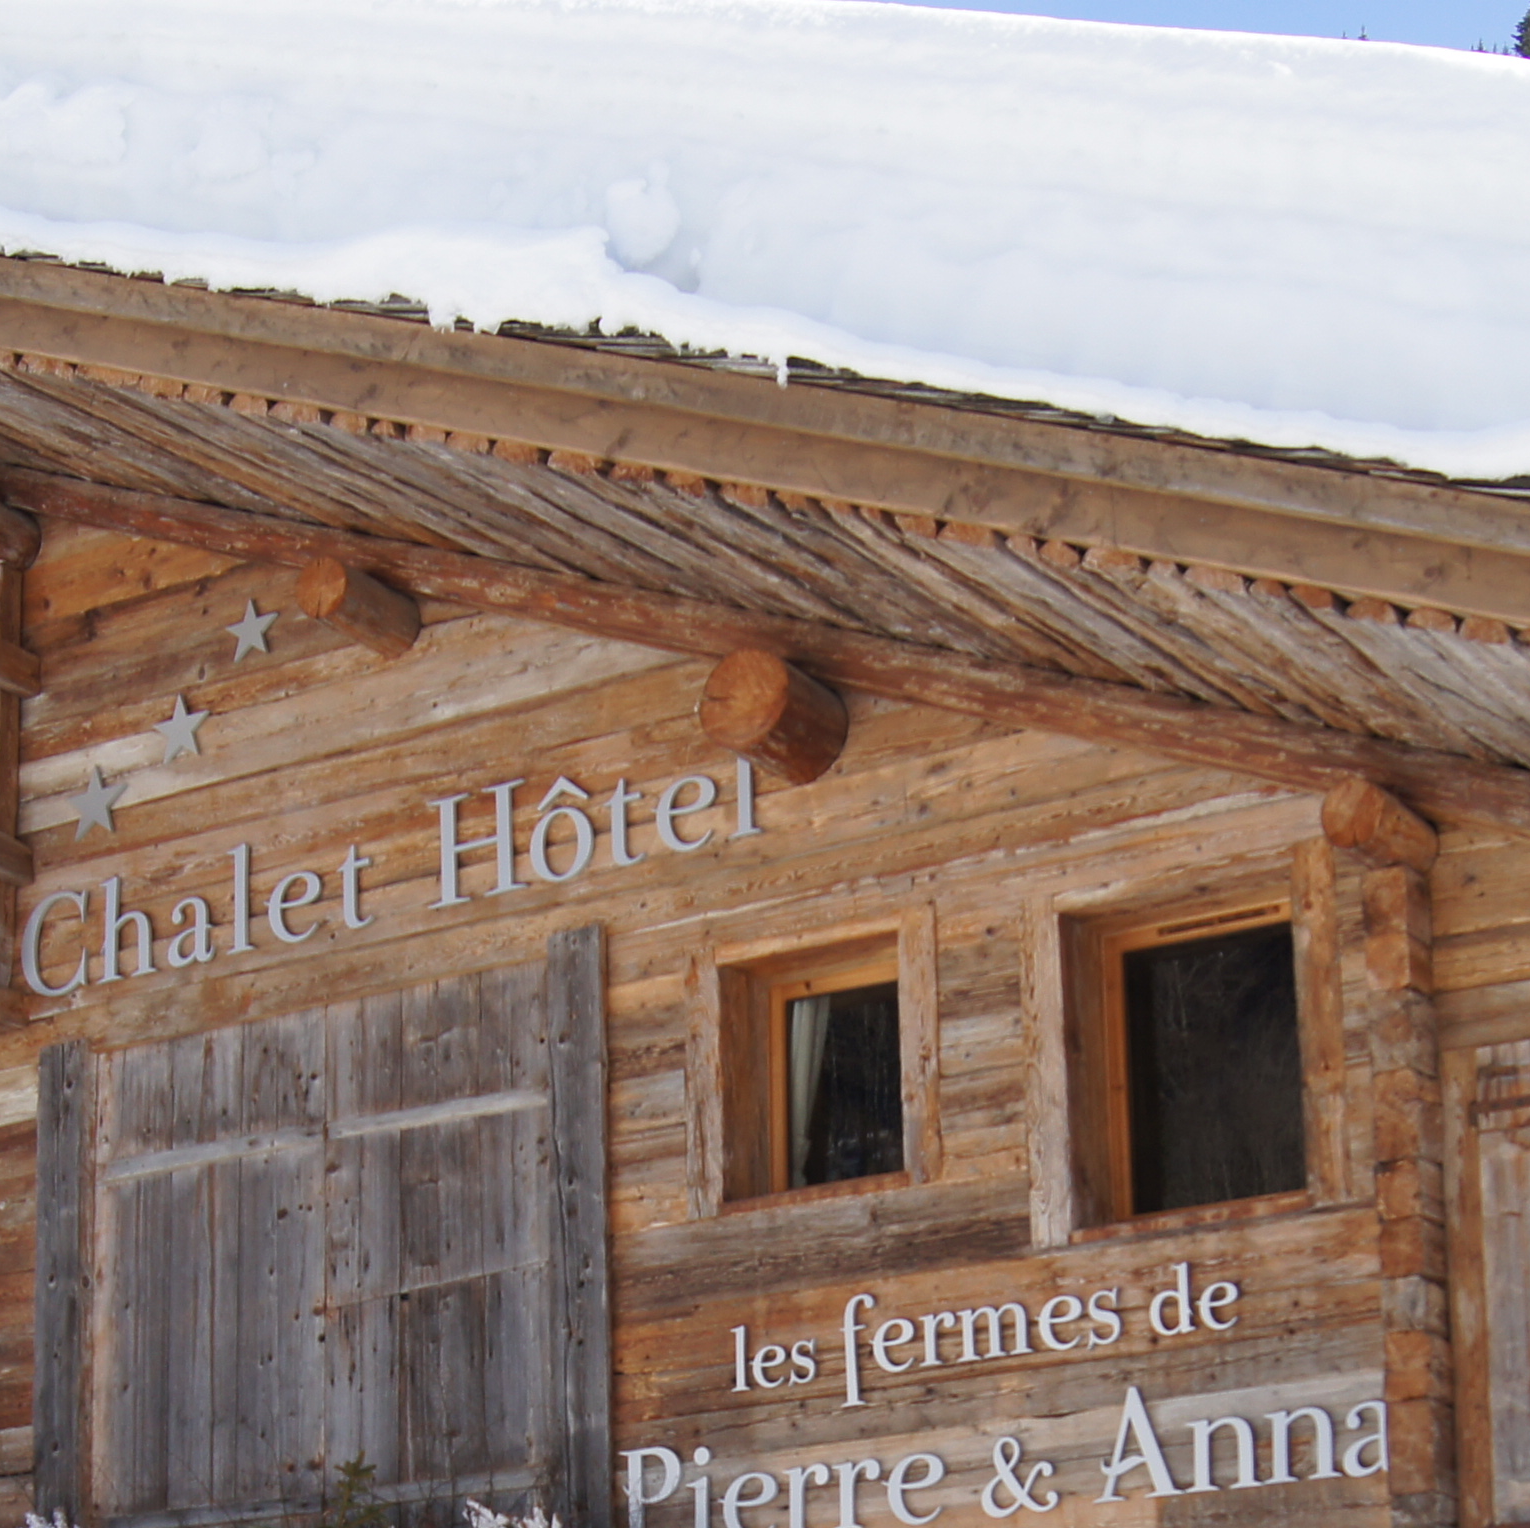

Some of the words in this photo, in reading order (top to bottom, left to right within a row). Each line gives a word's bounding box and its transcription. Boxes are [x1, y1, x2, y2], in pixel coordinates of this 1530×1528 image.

[21, 843, 373, 998] Chalet
[428, 757, 762, 910] Hôtel
[730, 1325, 817, 1393] les
[840, 1290, 1122, 1408] fermes
[1150, 1261, 1240, 1338] de
[980, 1436, 1059, 1519] &
[1093, 1386, 1389, 1505] Anna
